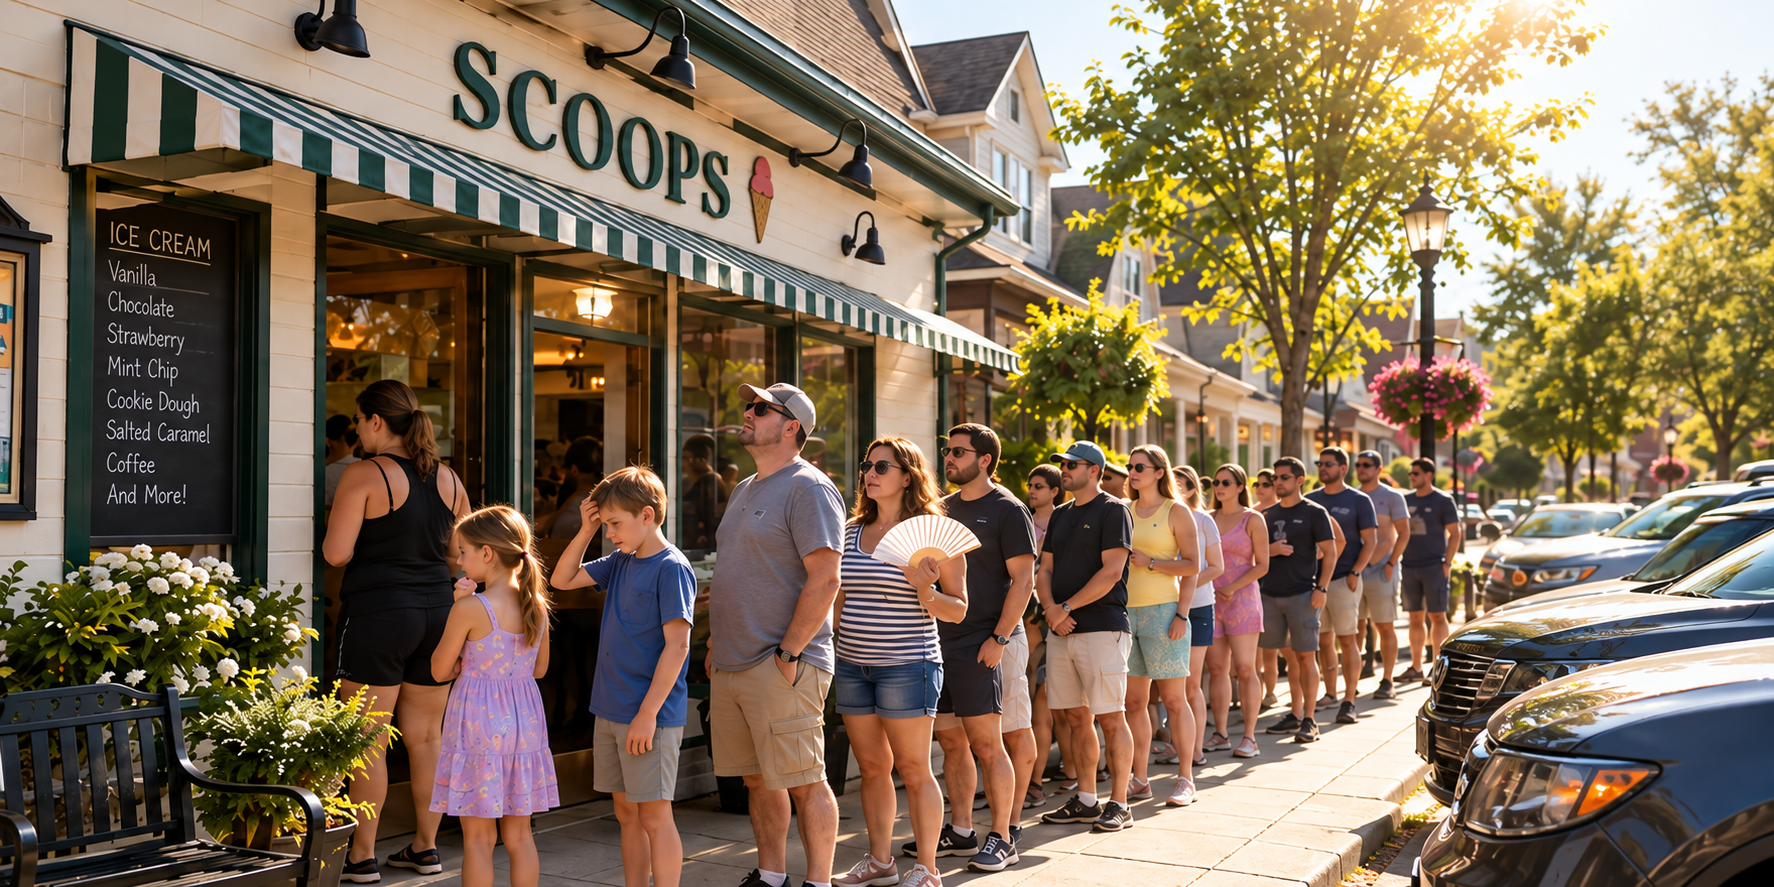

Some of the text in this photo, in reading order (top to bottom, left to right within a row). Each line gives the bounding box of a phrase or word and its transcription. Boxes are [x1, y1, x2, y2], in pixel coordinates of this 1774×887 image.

[453, 41, 731, 219] SCOOPS
[110, 221, 211, 260] ICE CREAM
[108, 259, 157, 287] Vanilla
[108, 290, 175, 319] Chocolate
[107, 322, 185, 356] Strawberry
[108, 355, 179, 387] Mint Chip
[107, 388, 200, 420] Cookie Dough
[106, 419, 211, 444] Salted Caramel
[106, 451, 156, 474] Coffee
[106, 483, 187, 506] And More!
